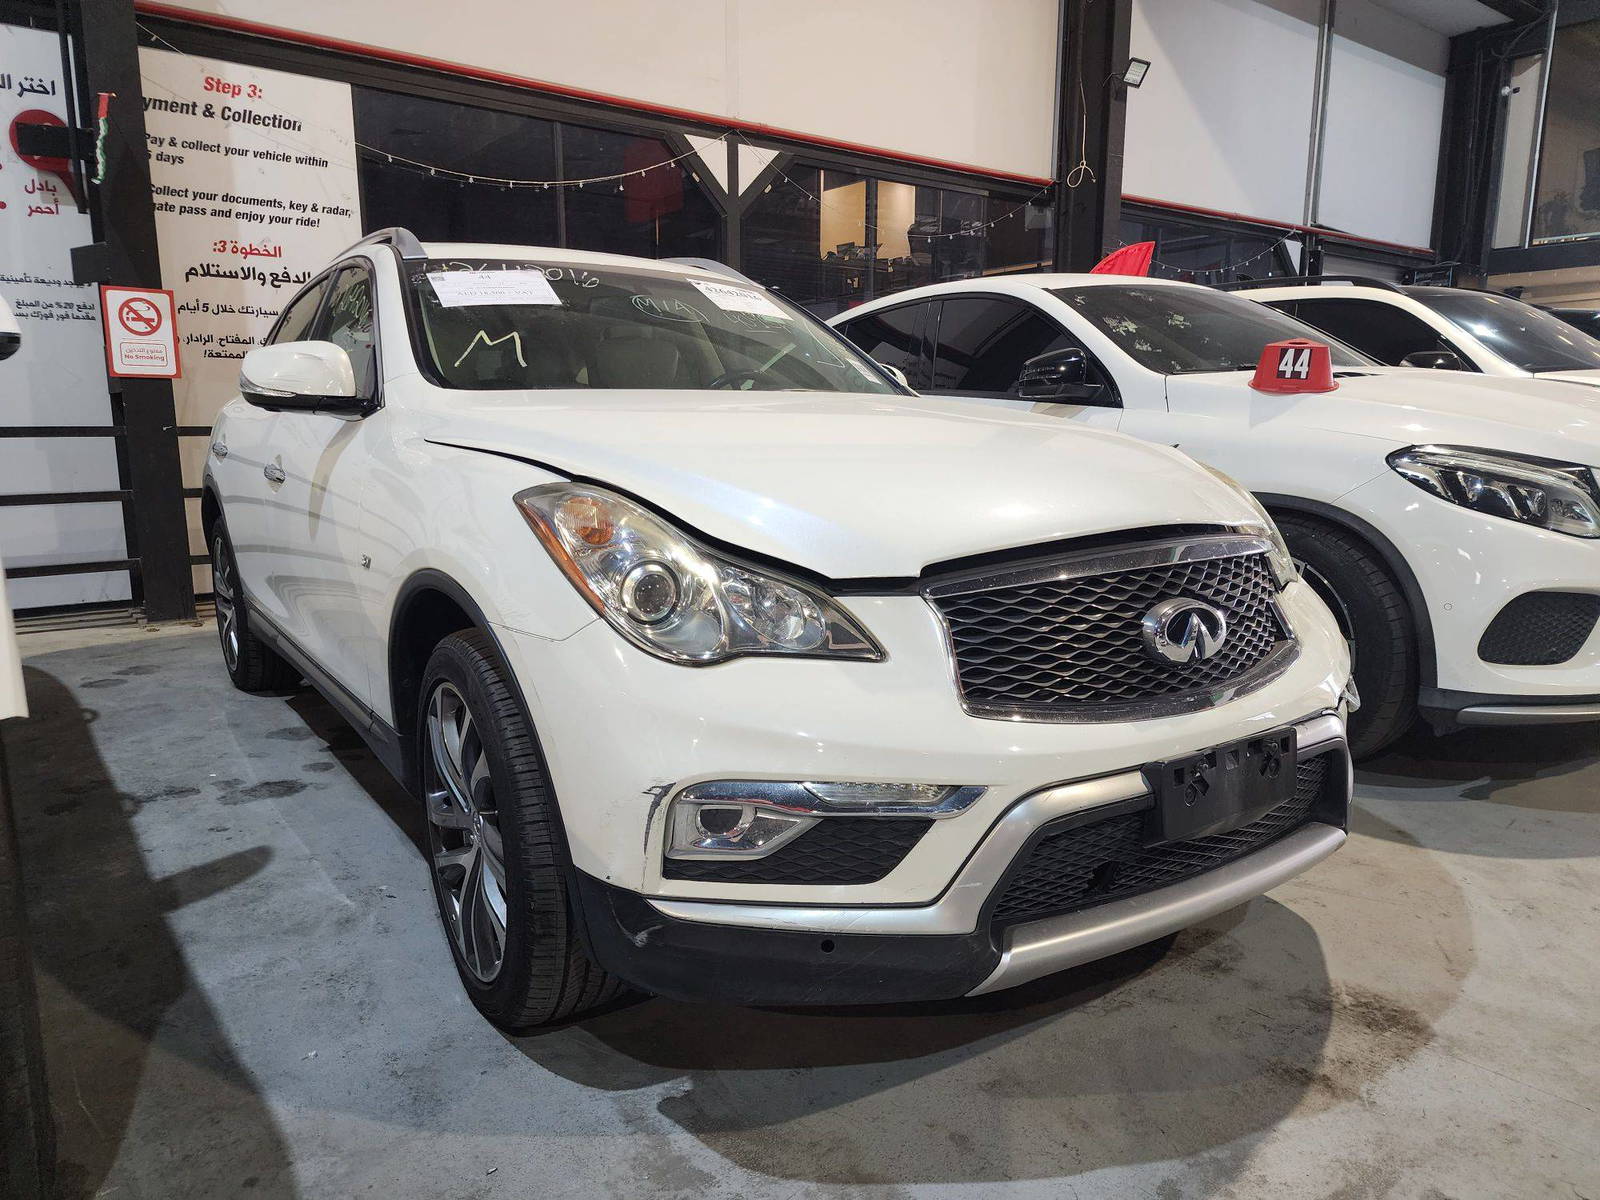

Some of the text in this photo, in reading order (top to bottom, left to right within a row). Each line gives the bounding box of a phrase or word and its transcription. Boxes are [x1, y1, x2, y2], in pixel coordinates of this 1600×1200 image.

[17, 76, 56, 98] اختر
[203, 76, 262, 99] Step 3:
[202, 103, 215, 119] &
[221, 106, 303, 132] Collection
[155, 151, 185, 166] days
[168, 136, 178, 148] &
[181, 140, 221, 154] collect
[223, 145, 250, 158] your
[253, 150, 292, 163] vehicle
[295, 155, 329, 168] within
[24, 178, 57, 196] بادل
[27, 197, 59, 217] أحمر
[192, 189, 218, 202] your
[221, 192, 286, 211] documents,
[289, 200, 308, 213] key
[310, 202, 319, 213] &
[321, 205, 352, 218] radar,
[179, 205, 208, 216] pass
[210, 208, 232, 219] and
[235, 210, 265, 224] enjoy
[268, 215, 293, 225] your
[295, 216, 321, 228] ride!
[230, 240, 282, 260] الخطوة
[184, 262, 268, 287] والاستلام
[177, 298, 200, 314] أيام
[201, 302, 210, 313] 5
[211, 304, 236, 316] خلال
[1278, 348, 1312, 379] 44
